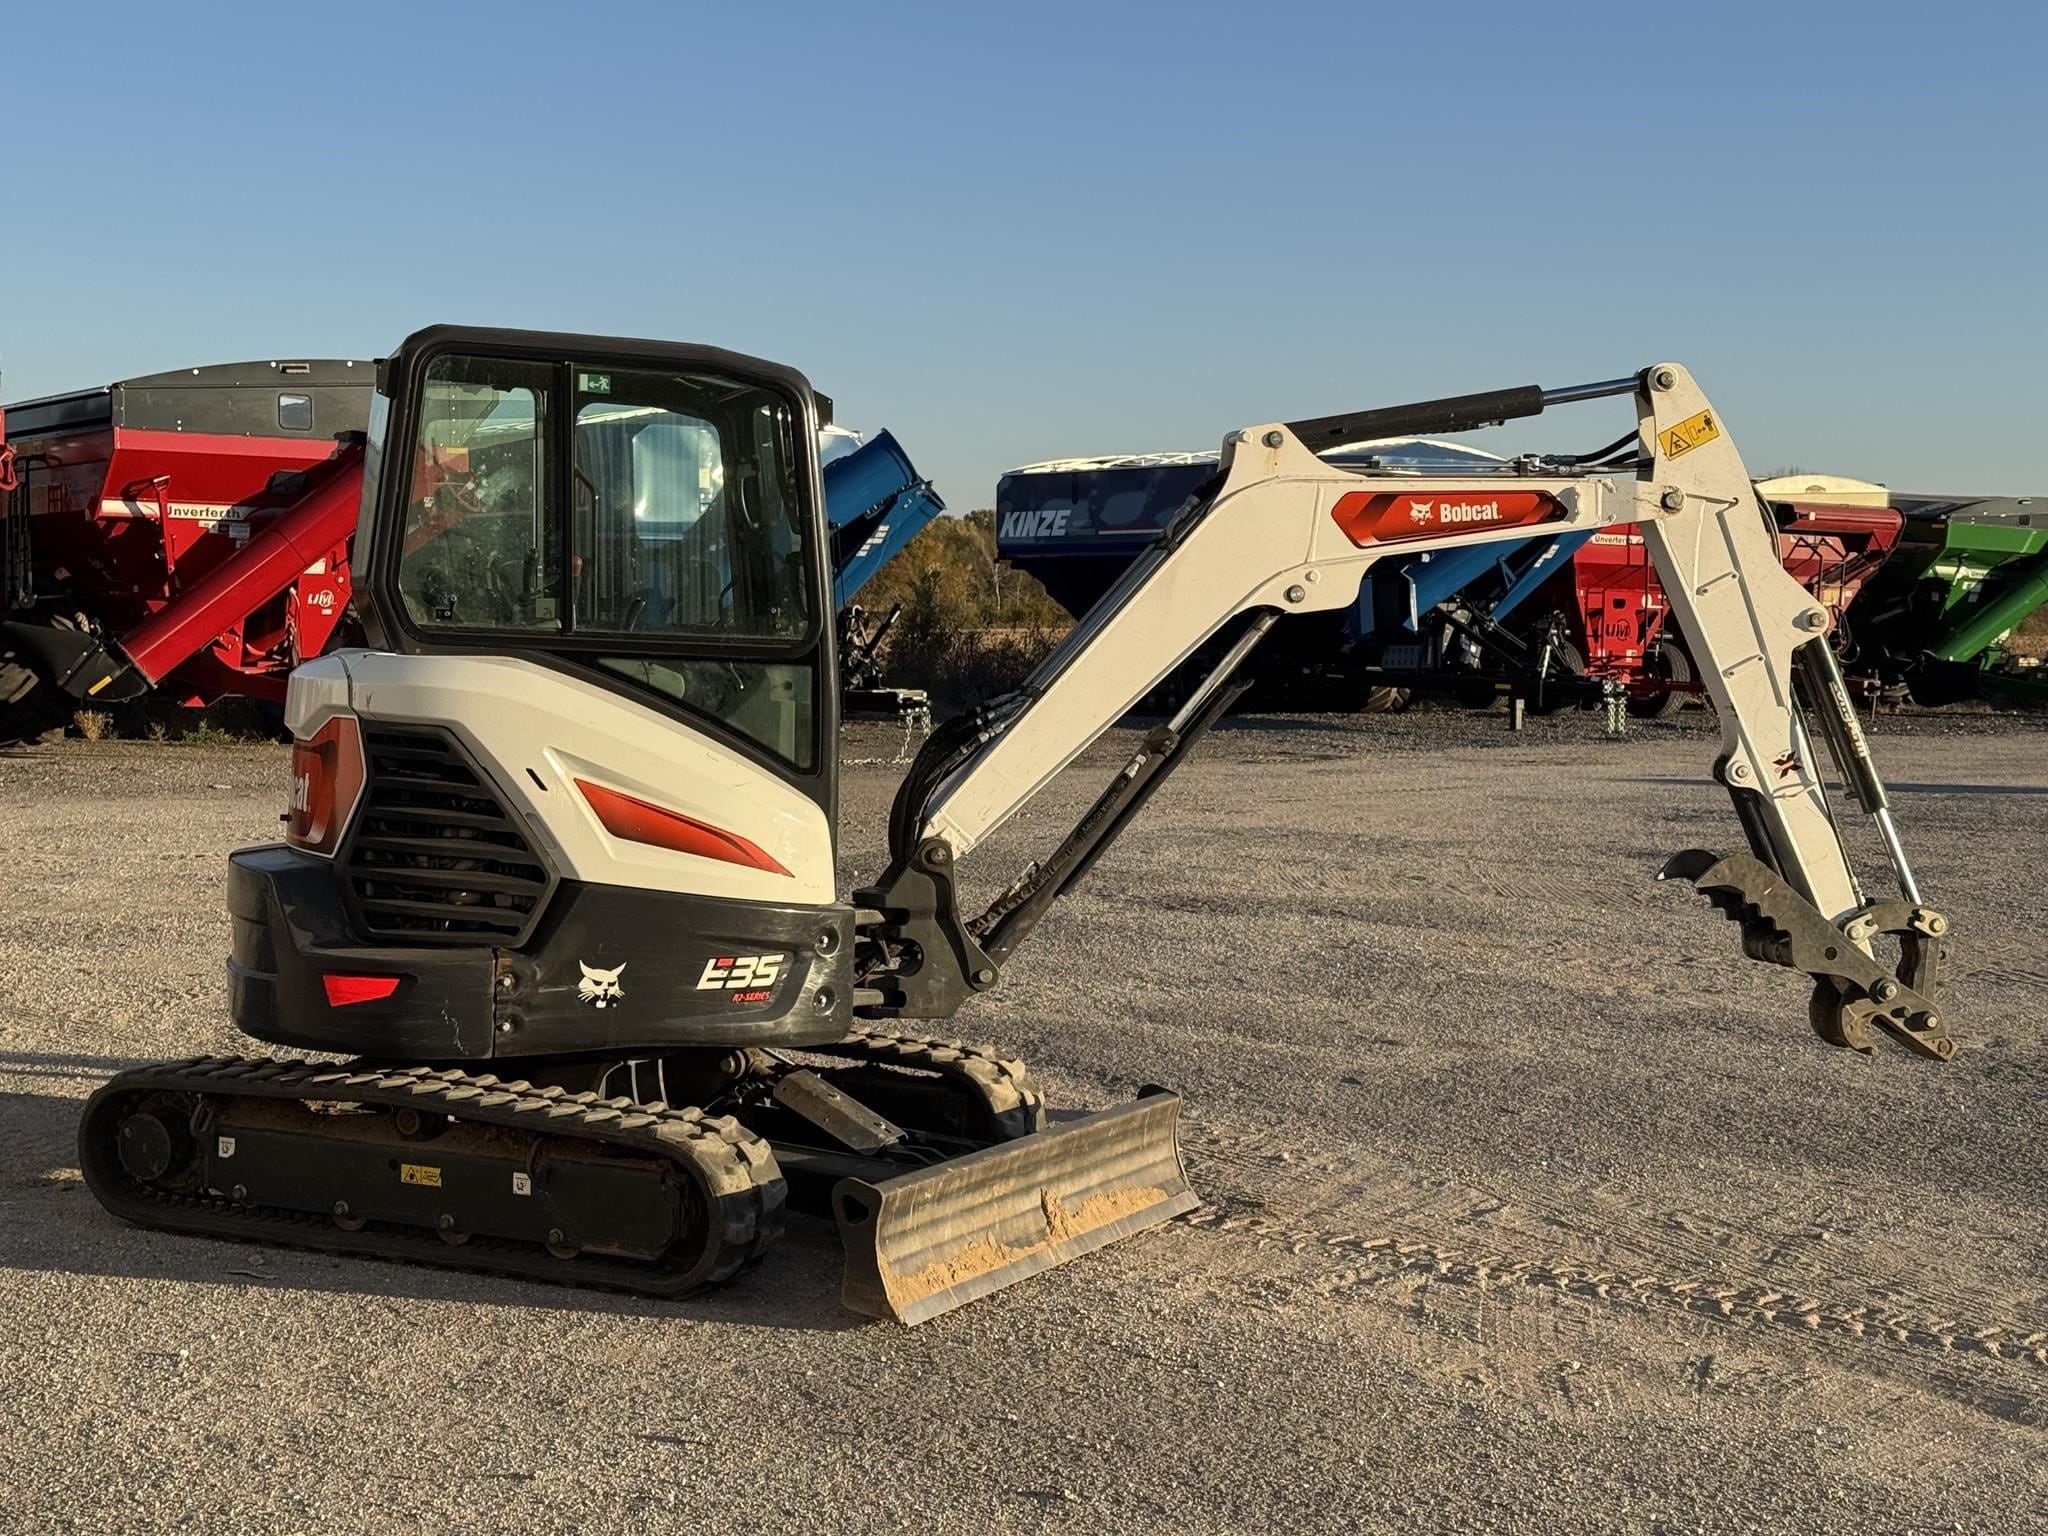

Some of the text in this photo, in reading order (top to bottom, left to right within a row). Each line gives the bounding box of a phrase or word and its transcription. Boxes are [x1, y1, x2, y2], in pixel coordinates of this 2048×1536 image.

[1000, 510, 1072, 538] KINZE
[1440, 501, 1500, 522] Bobcat
[1594, 535, 1632, 544] Unverferh
[289, 770, 310, 812] cat
[696, 954, 785, 990] E35
